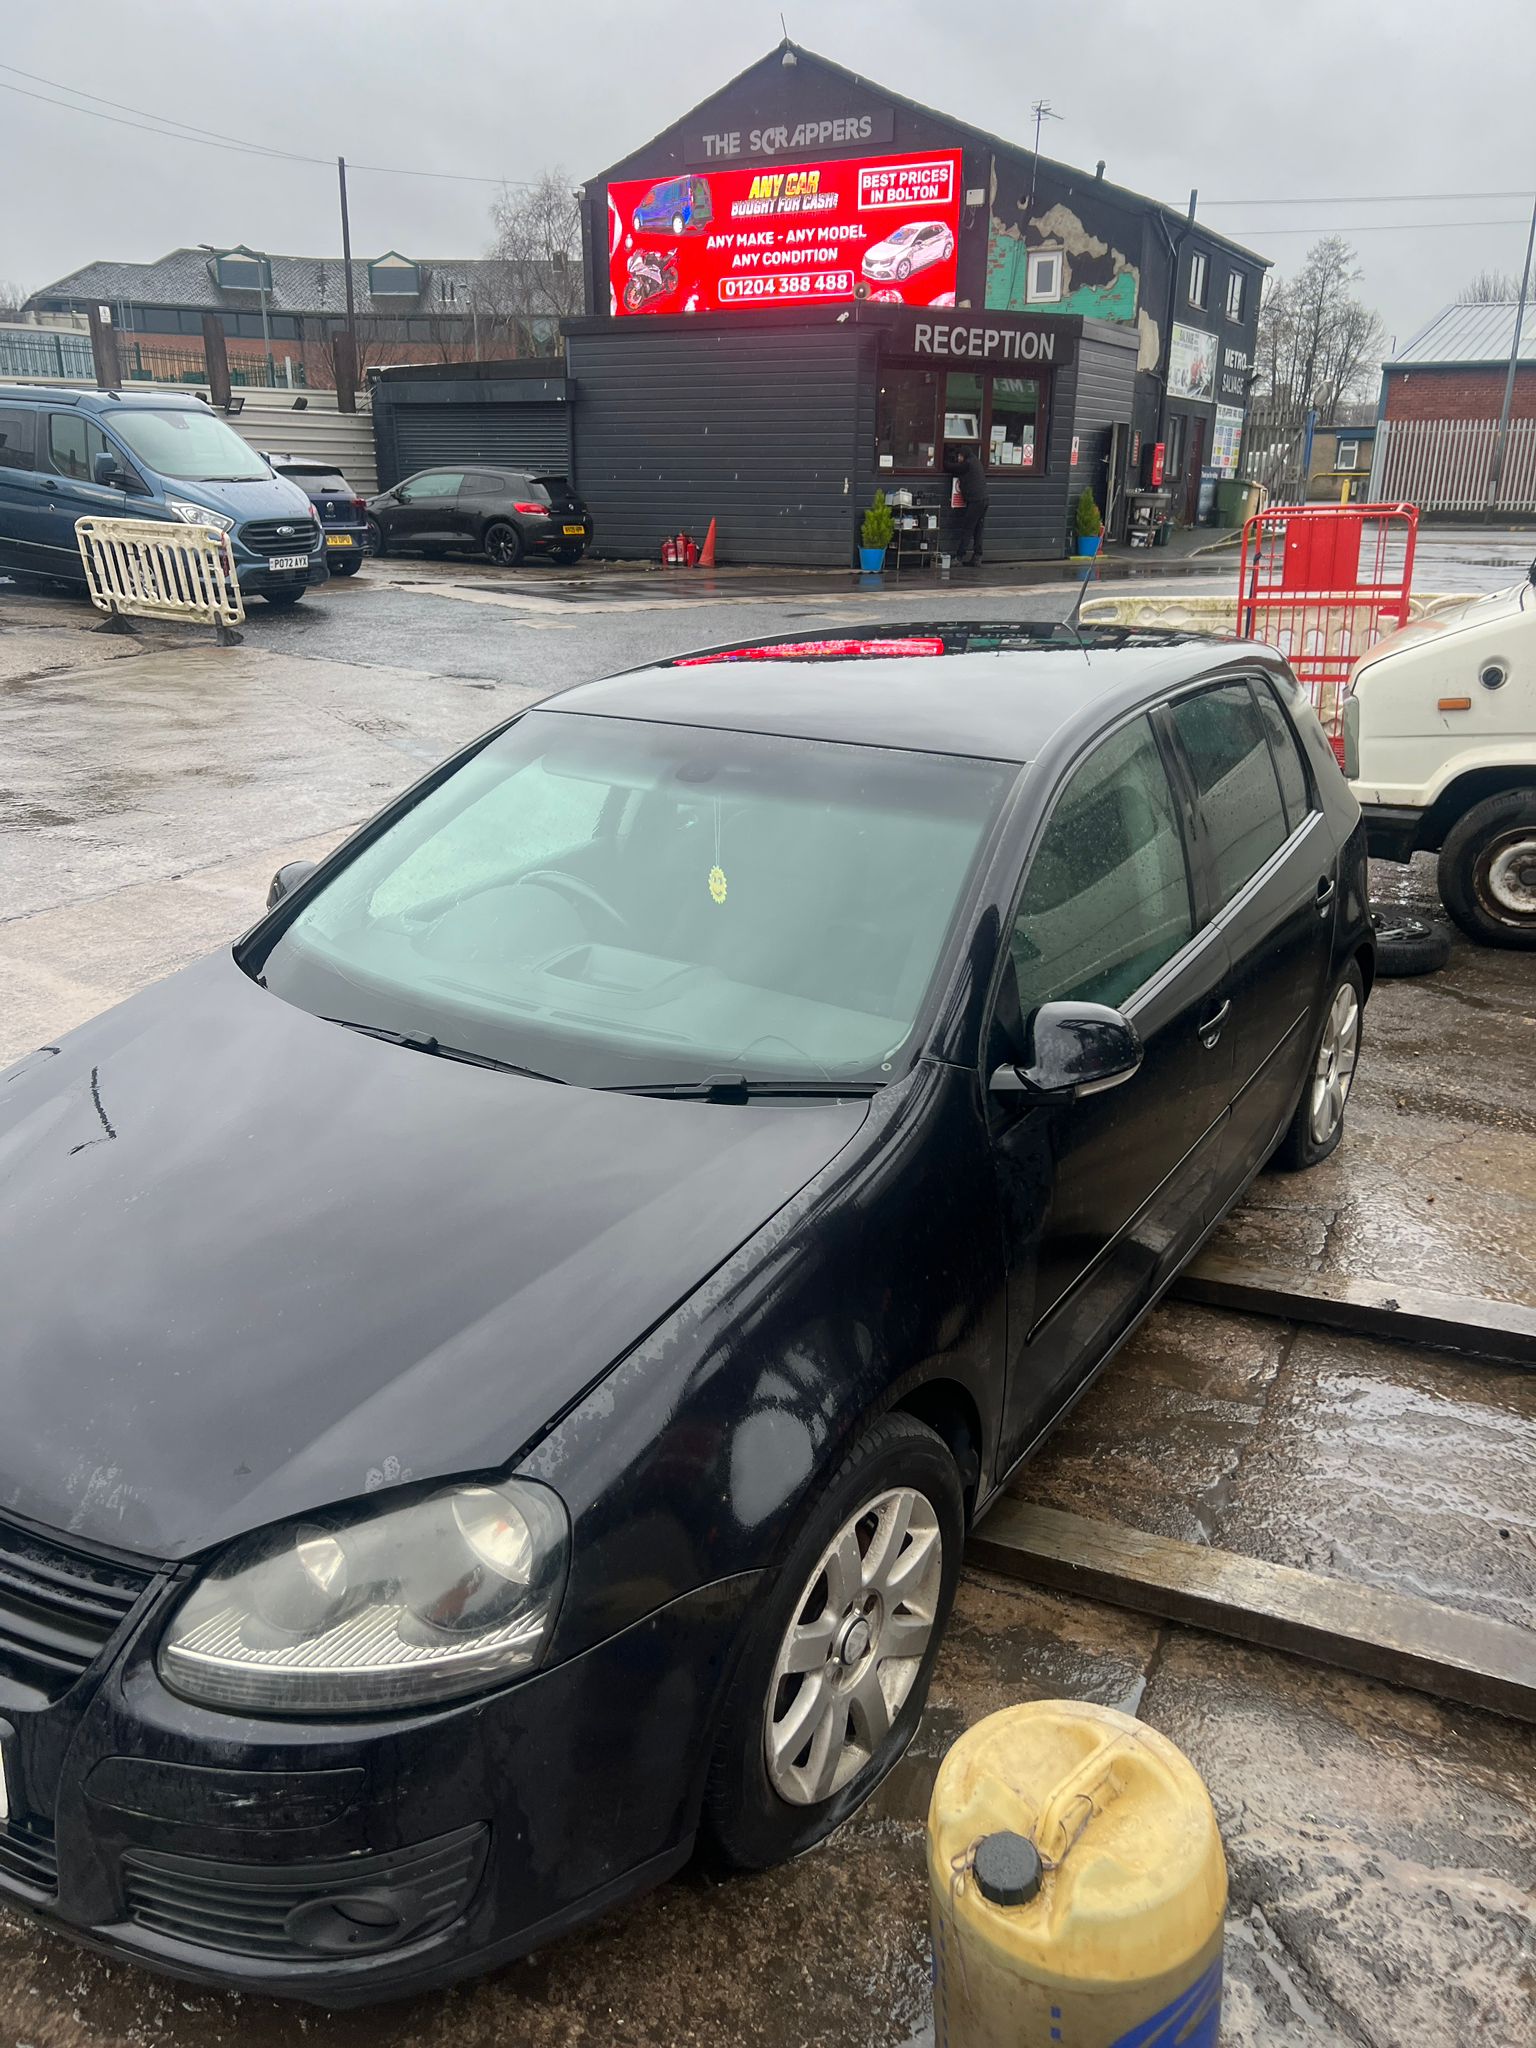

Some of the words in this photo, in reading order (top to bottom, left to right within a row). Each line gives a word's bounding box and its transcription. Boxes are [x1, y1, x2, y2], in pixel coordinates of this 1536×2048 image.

[702, 132, 741, 157] THE
[749, 115, 873, 155] SCRAPPERS
[748, 174, 784, 199] ANY
[785, 170, 820, 196] CAR
[863, 173, 897, 189] BEST
[899, 168, 949, 186] PRICES
[870, 189, 884, 204] IN
[886, 184, 939, 202] BOLTON
[731, 199, 775, 217] BOUGHT
[777, 197, 801, 213] FOR
[706, 234, 735, 250] ANY
[736, 231, 774, 247] MAKE
[785, 228, 816, 244] ANY
[817, 224, 868, 242] MODEL
[731, 253, 760, 269] ANY
[762, 247, 839, 266] CONDITION
[725, 278, 776, 296] 01204
[779, 275, 811, 293] 388
[815, 274, 848, 291] 488
[914, 323, 1055, 361] RECEPTION
[1223, 347, 1247, 371] METRO
[1221, 373, 1245, 396] SALVAGE
[294, 556, 307, 566] AYX
